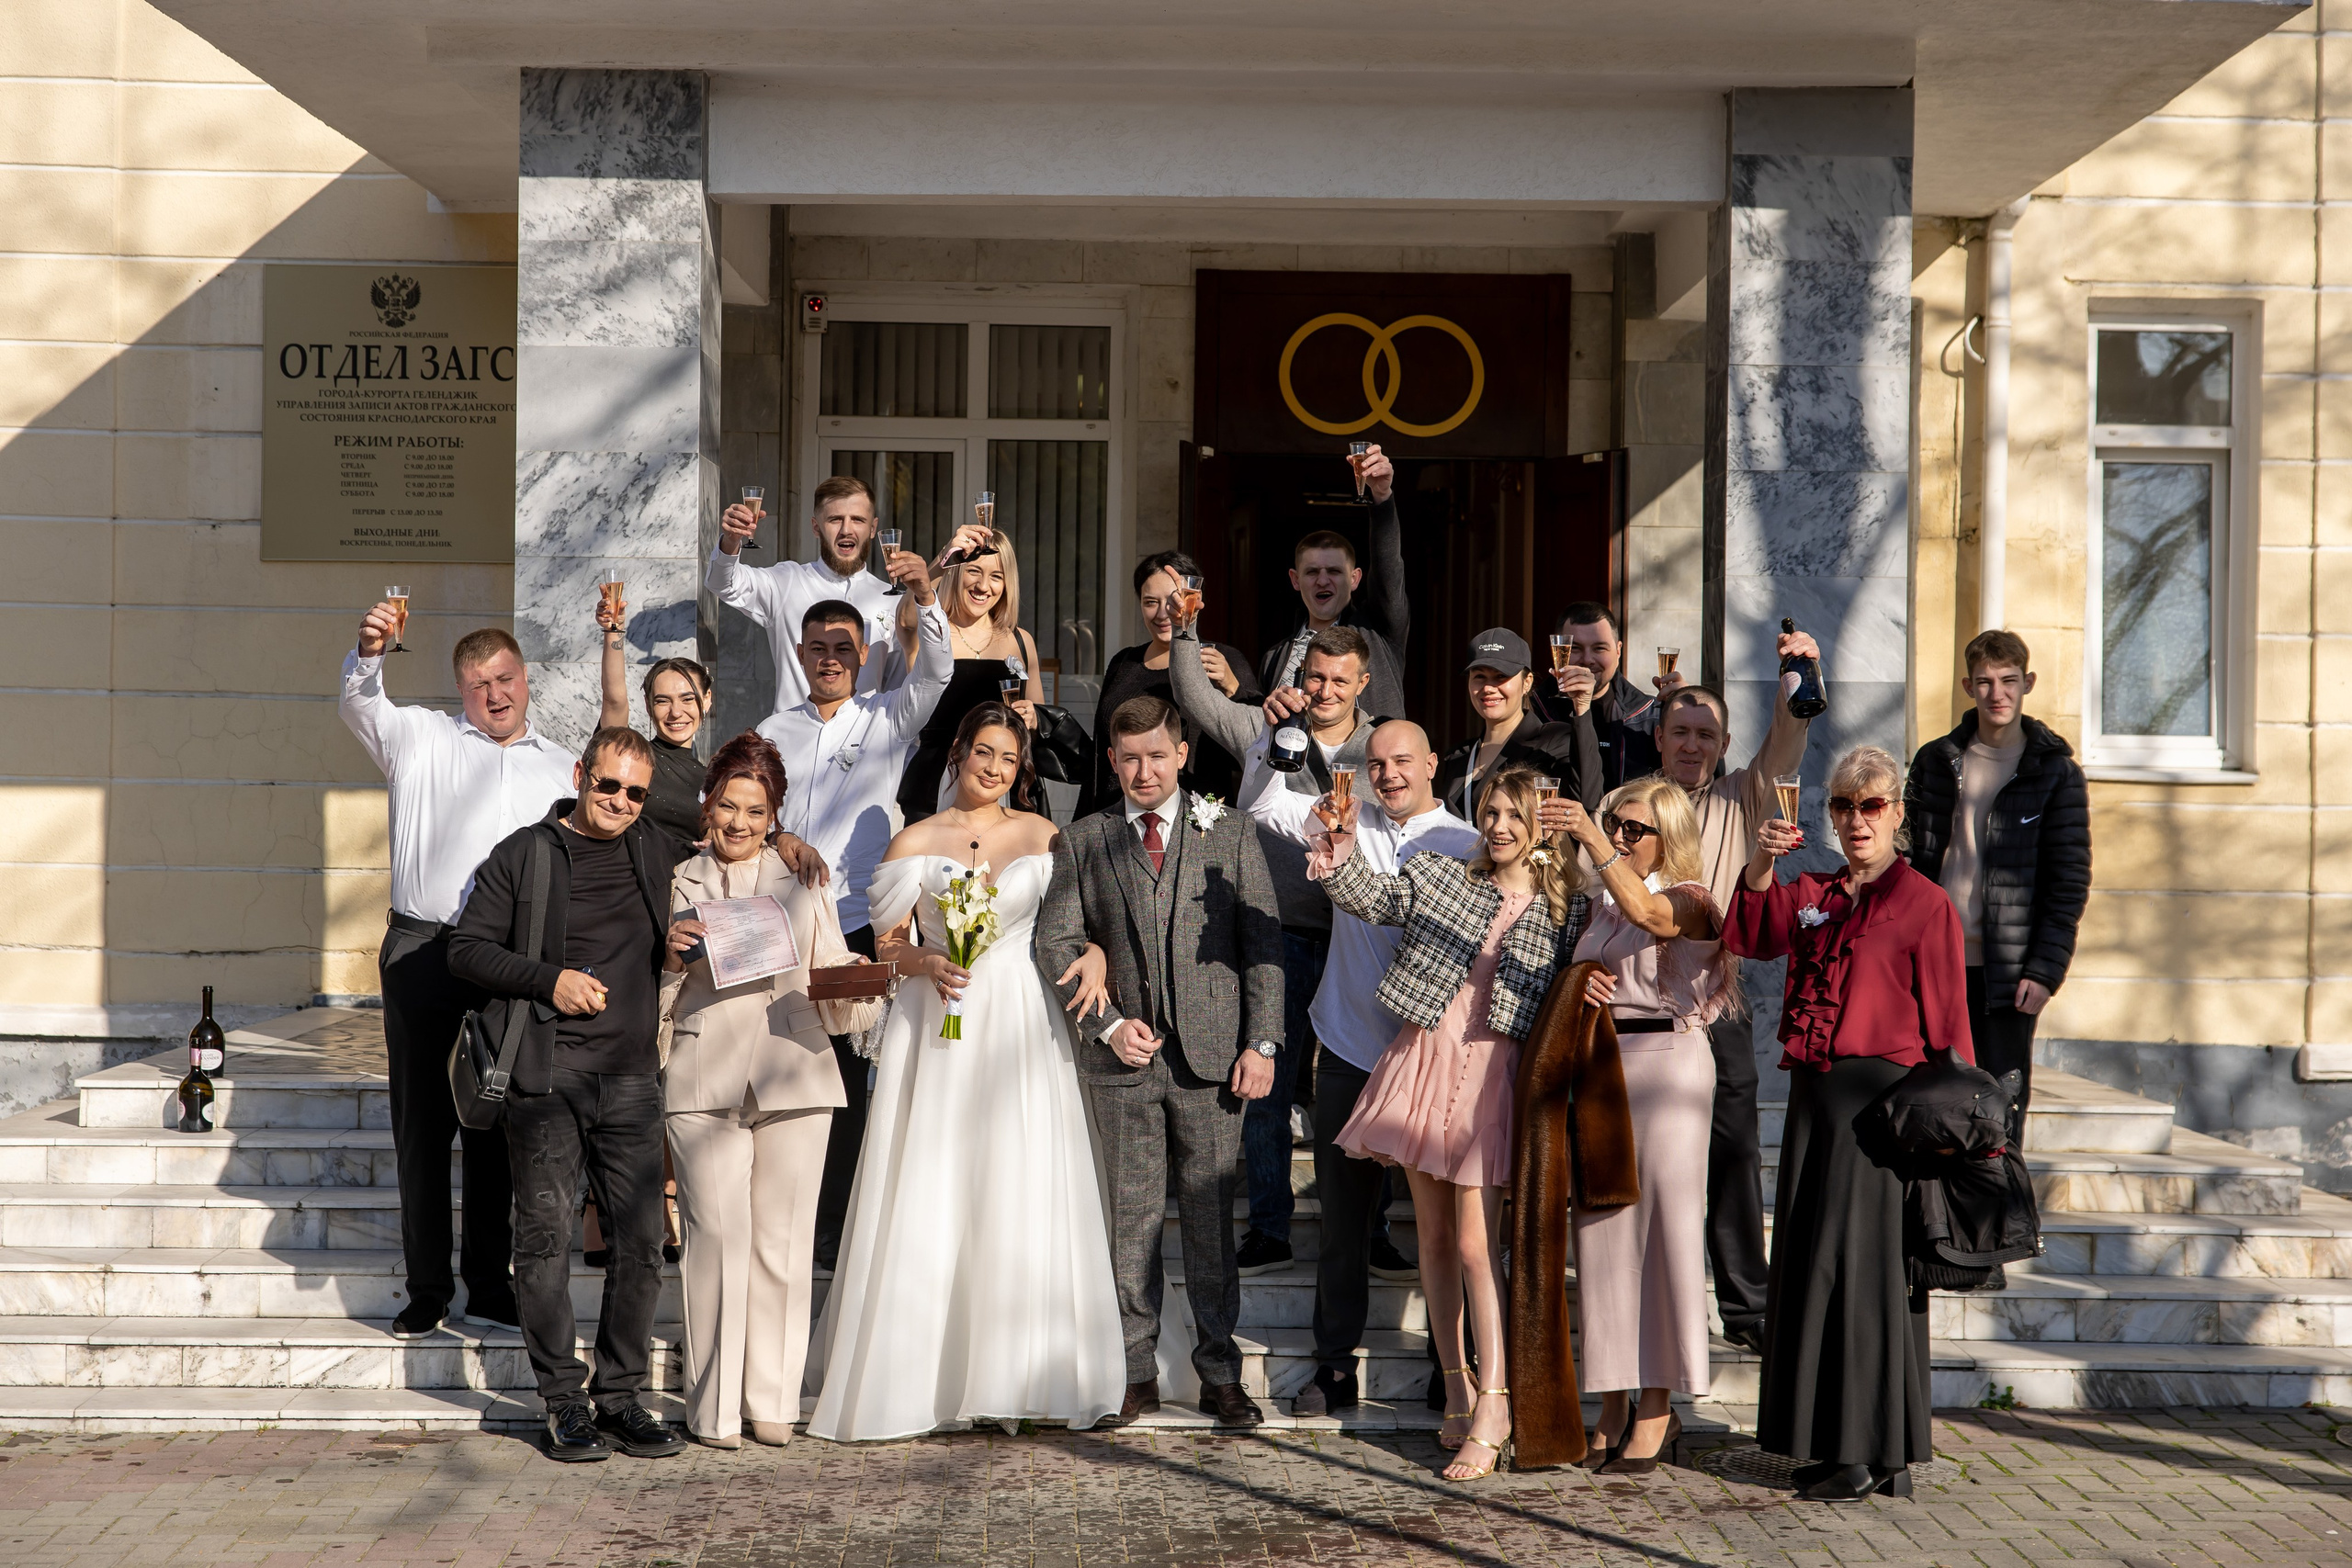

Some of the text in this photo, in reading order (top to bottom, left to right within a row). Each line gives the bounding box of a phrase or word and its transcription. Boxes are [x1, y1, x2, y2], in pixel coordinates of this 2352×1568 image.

[279, 343, 514, 388] ОТДЕЛ ЗАГС
[318, 389, 479, 400] ГОРОДА-КУРОРТА ГЕЛЕНДЖИК
[276, 400, 516, 412] УПРАВЛЕНИЯ ЗАПИСИ АКТОВ ГРАЖДАНСКОГО
[300, 412, 497, 424] СОСТОЯНИЯ КРАСНОДАРСКОГО КРАЯ
[334, 434, 465, 448] РЕЖИМ РАБОТЫ:
[340, 480, 379, 489] ПЯТНИЦА
[354, 527, 441, 537] ВЫХОДНЫЕ ДНИ:
[340, 539, 394, 547] ВОСКРЕСЕНЬЕ,
